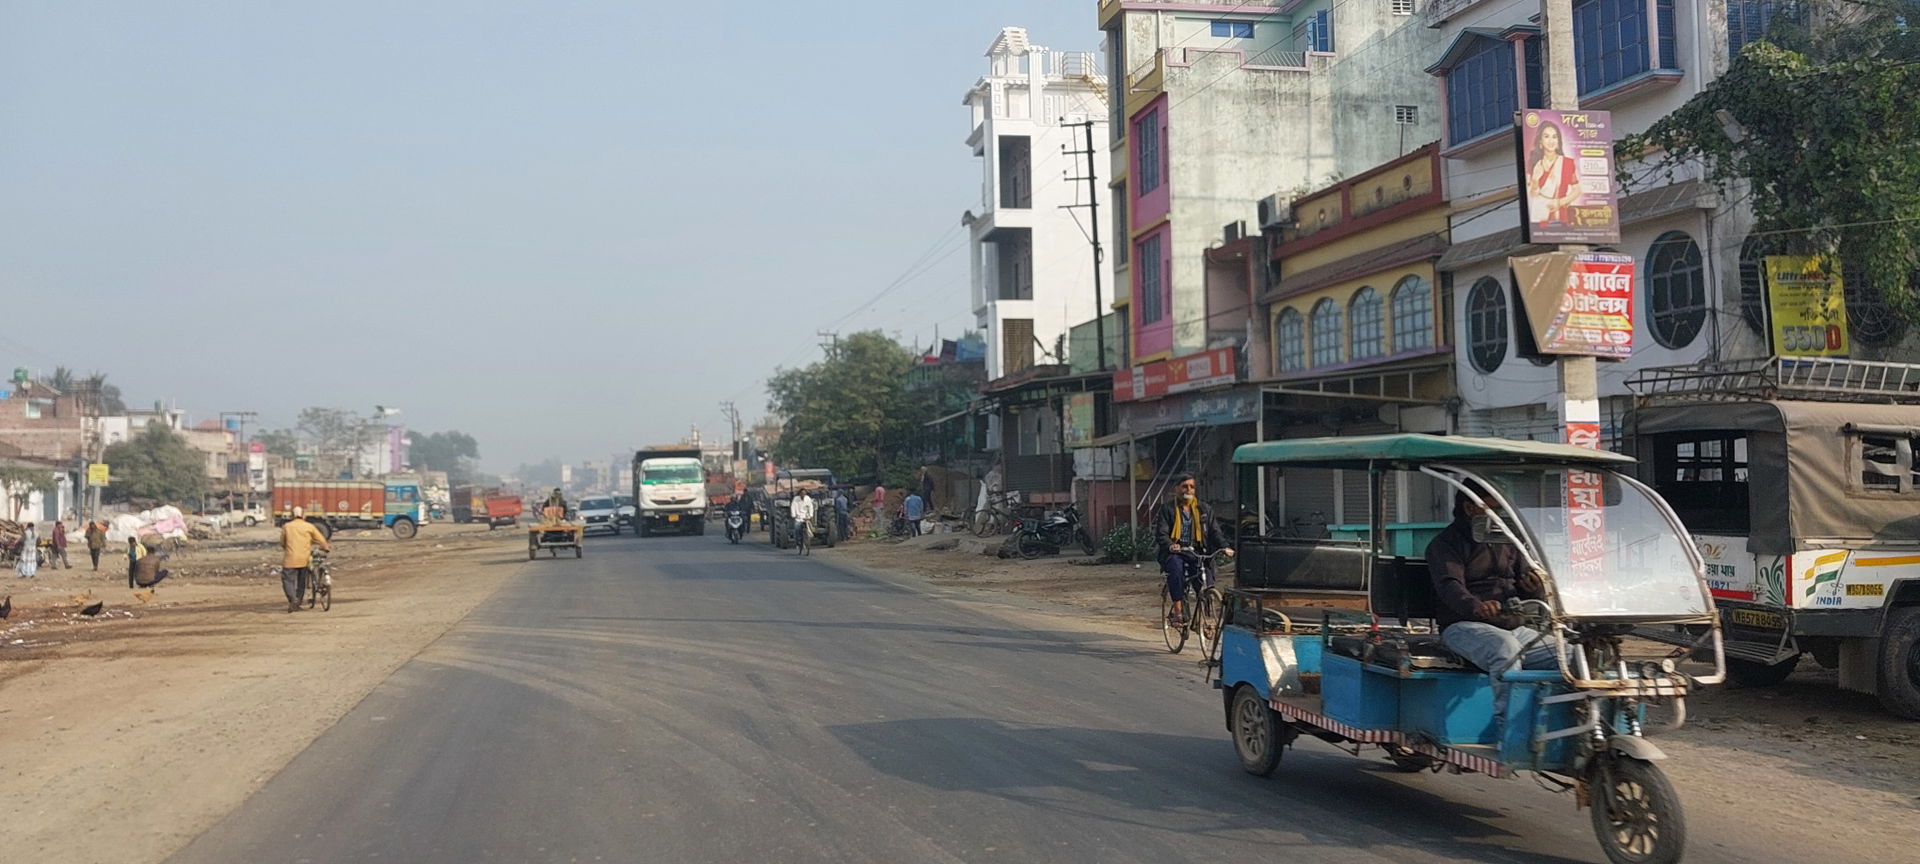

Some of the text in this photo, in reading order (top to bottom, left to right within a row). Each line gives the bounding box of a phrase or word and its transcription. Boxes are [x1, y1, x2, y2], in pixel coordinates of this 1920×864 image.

[1568, 265, 1632, 292] ক মার্বেল
[1782, 325, 1842, 351] 550D
[1816, 597, 1842, 605] INDIA
